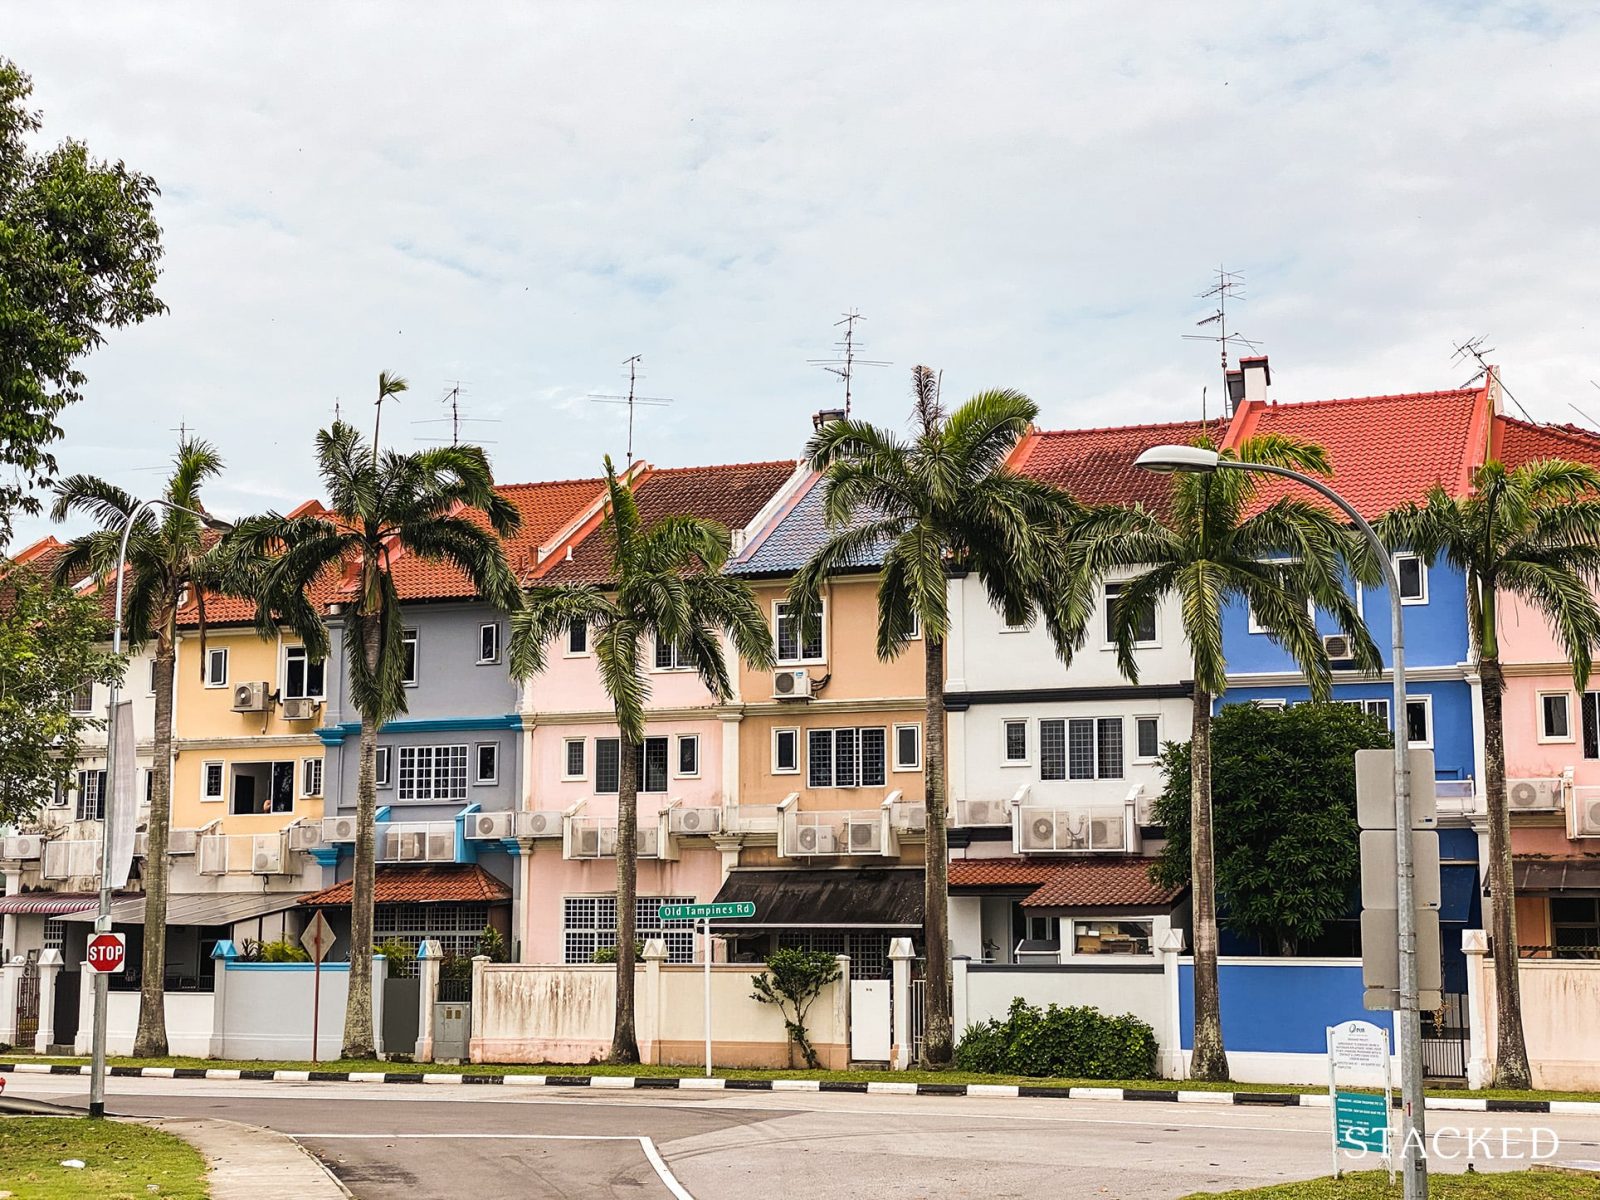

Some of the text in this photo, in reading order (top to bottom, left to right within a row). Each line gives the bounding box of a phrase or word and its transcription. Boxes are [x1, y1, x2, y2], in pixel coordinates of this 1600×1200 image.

[664, 904, 749, 917] Old Tampines Rd
[89, 945, 123, 961] STOP
